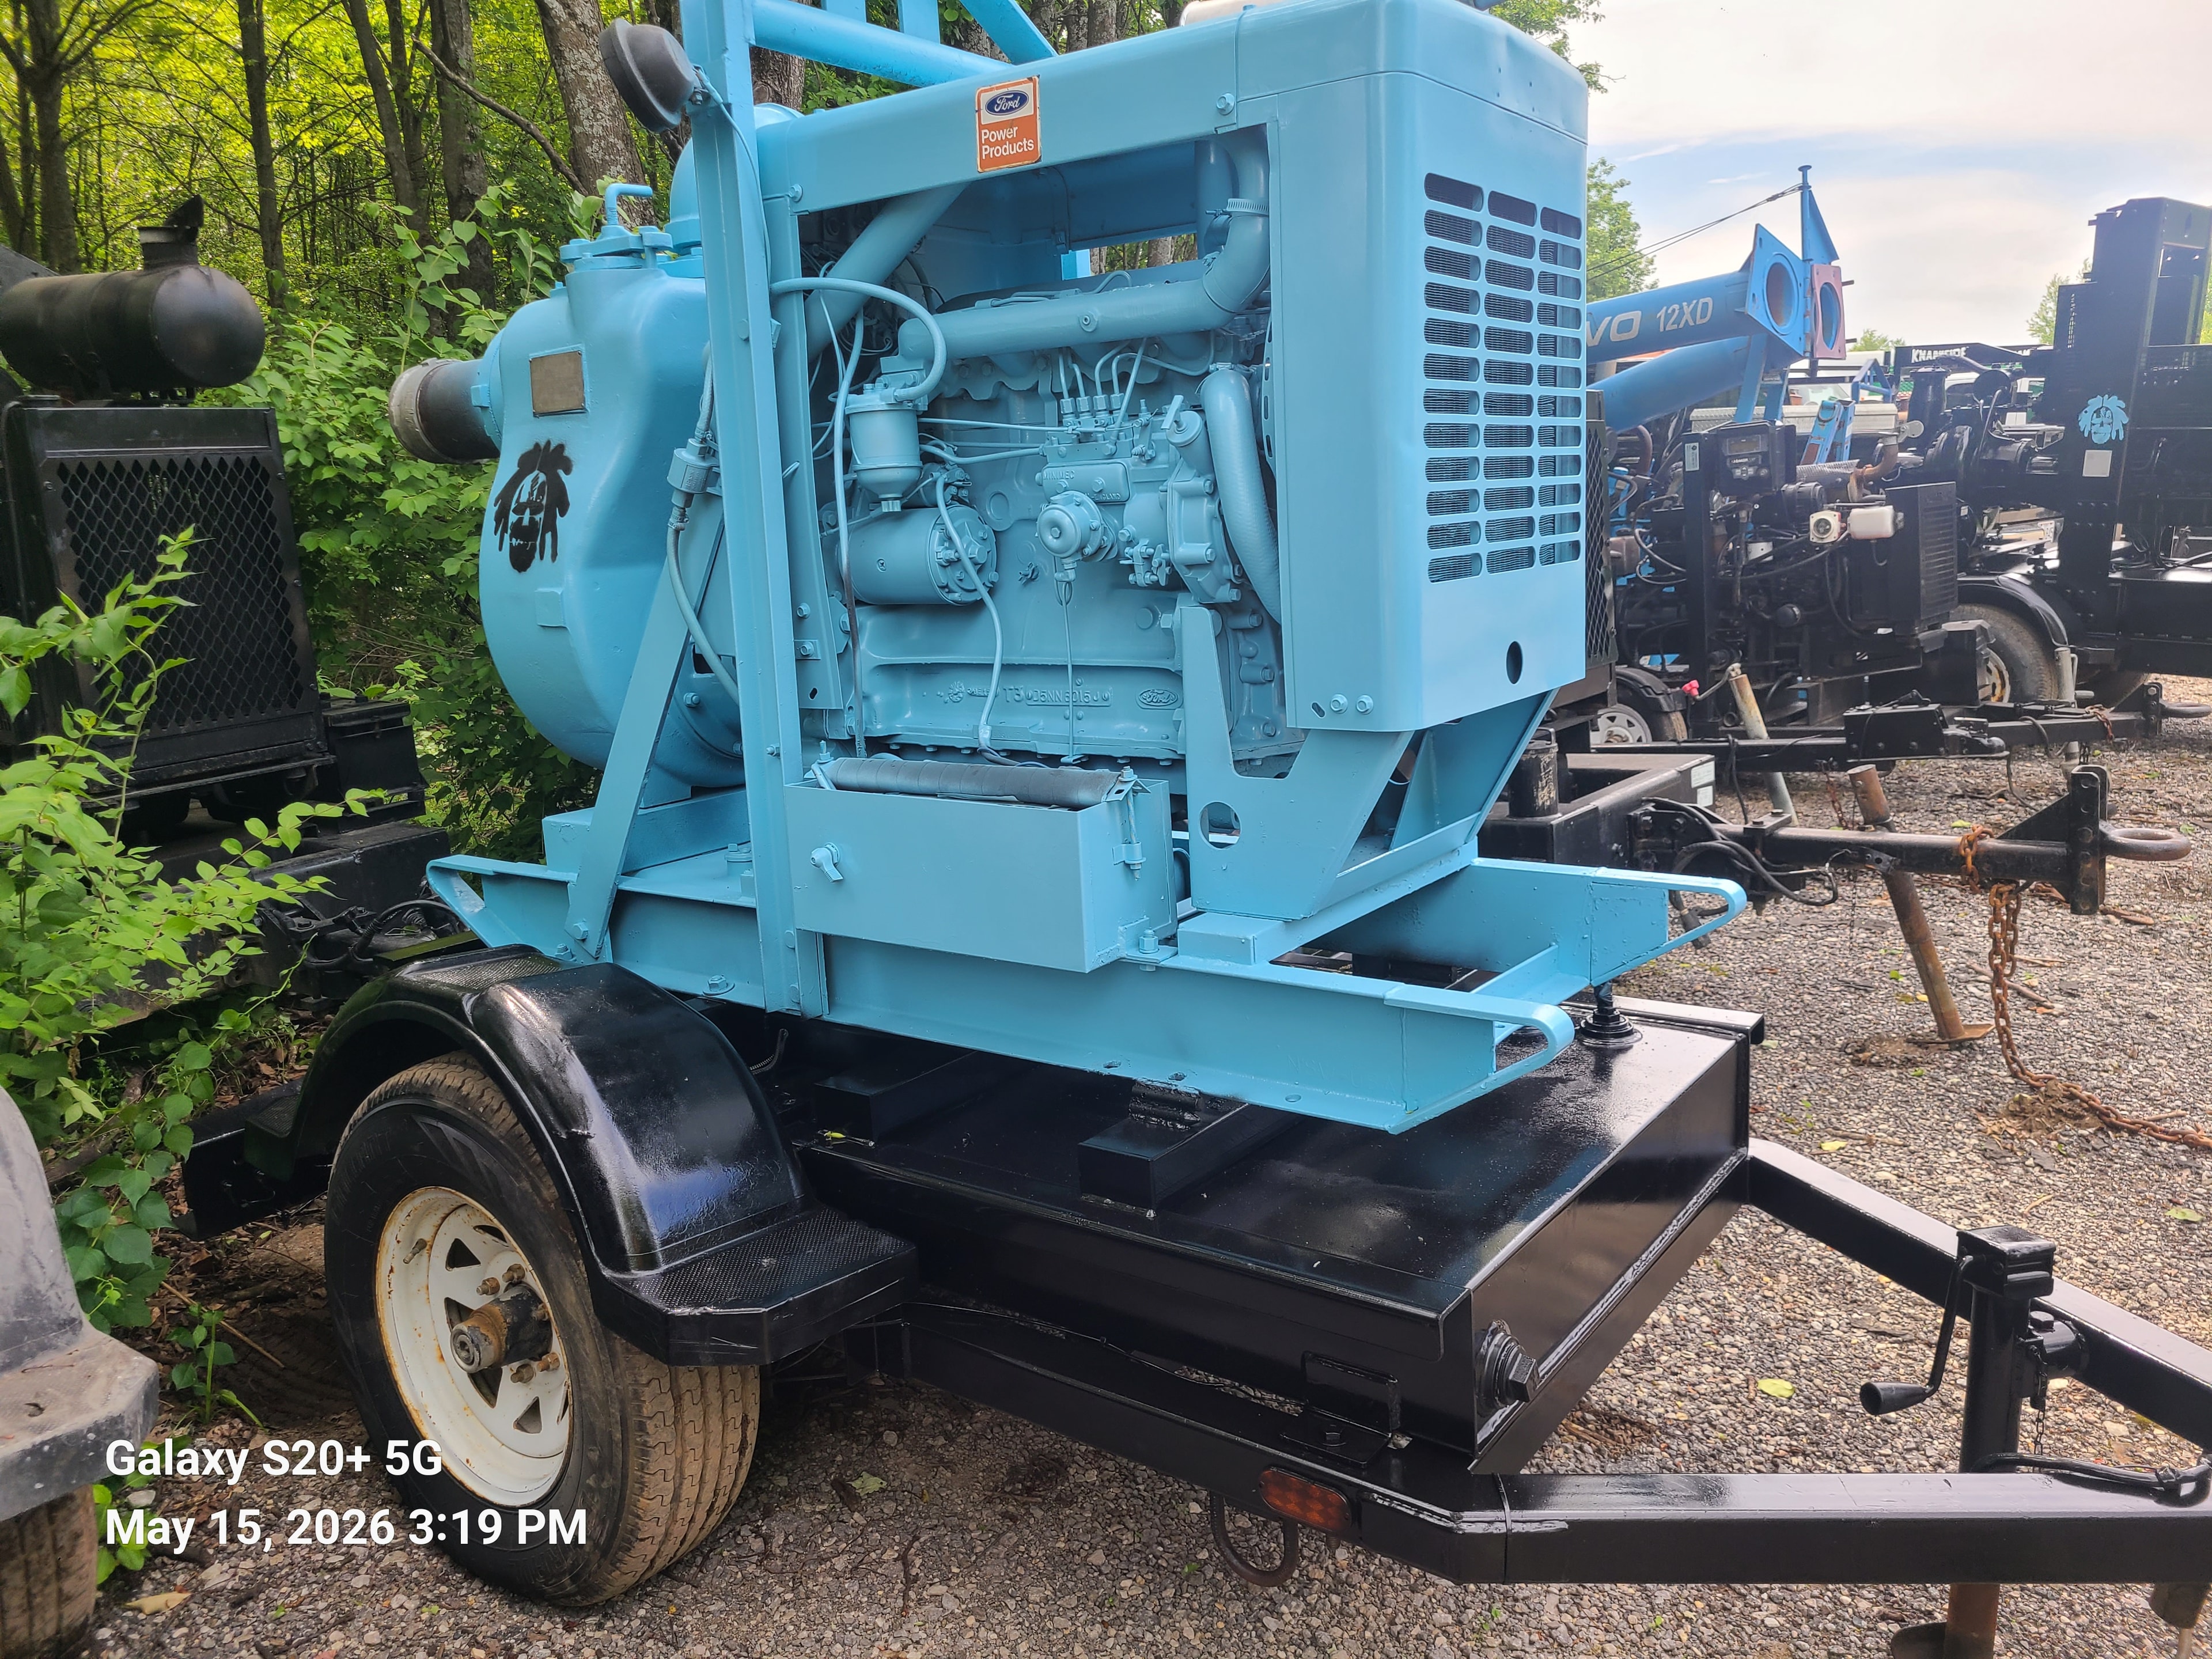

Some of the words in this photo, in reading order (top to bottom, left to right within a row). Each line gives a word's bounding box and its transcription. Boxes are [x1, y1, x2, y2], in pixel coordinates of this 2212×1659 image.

[994, 94, 1020, 112] Ford
[981, 126, 1018, 143] Power
[982, 138, 1034, 160] Products
[1656, 297, 1713, 332] 12XD
[1043, 470, 1075, 480] MINIMEC
